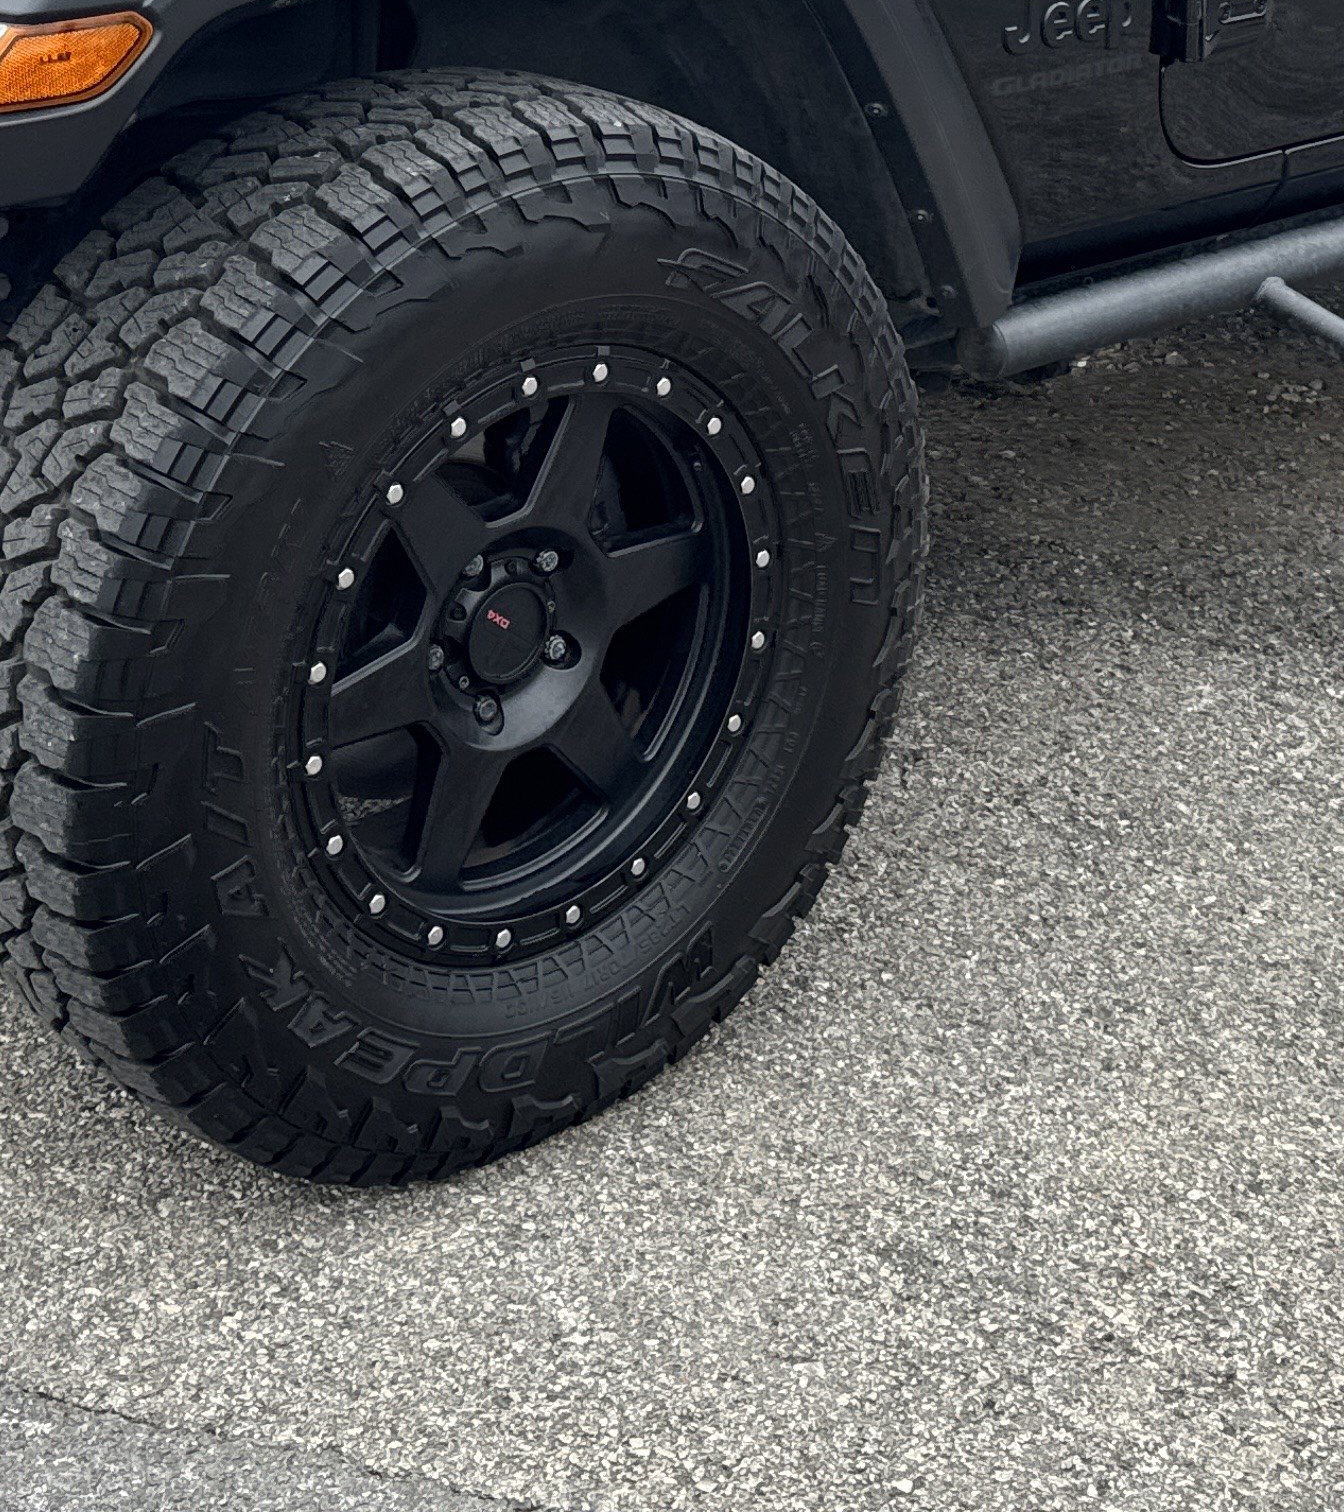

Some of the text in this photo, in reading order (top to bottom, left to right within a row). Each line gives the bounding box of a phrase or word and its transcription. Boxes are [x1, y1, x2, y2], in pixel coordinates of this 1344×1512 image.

[990, 52, 1144, 96] GLADIATOR
[657, 248, 881, 606] FALKEN
[239, 922, 713, 1093] WILDPEAK
